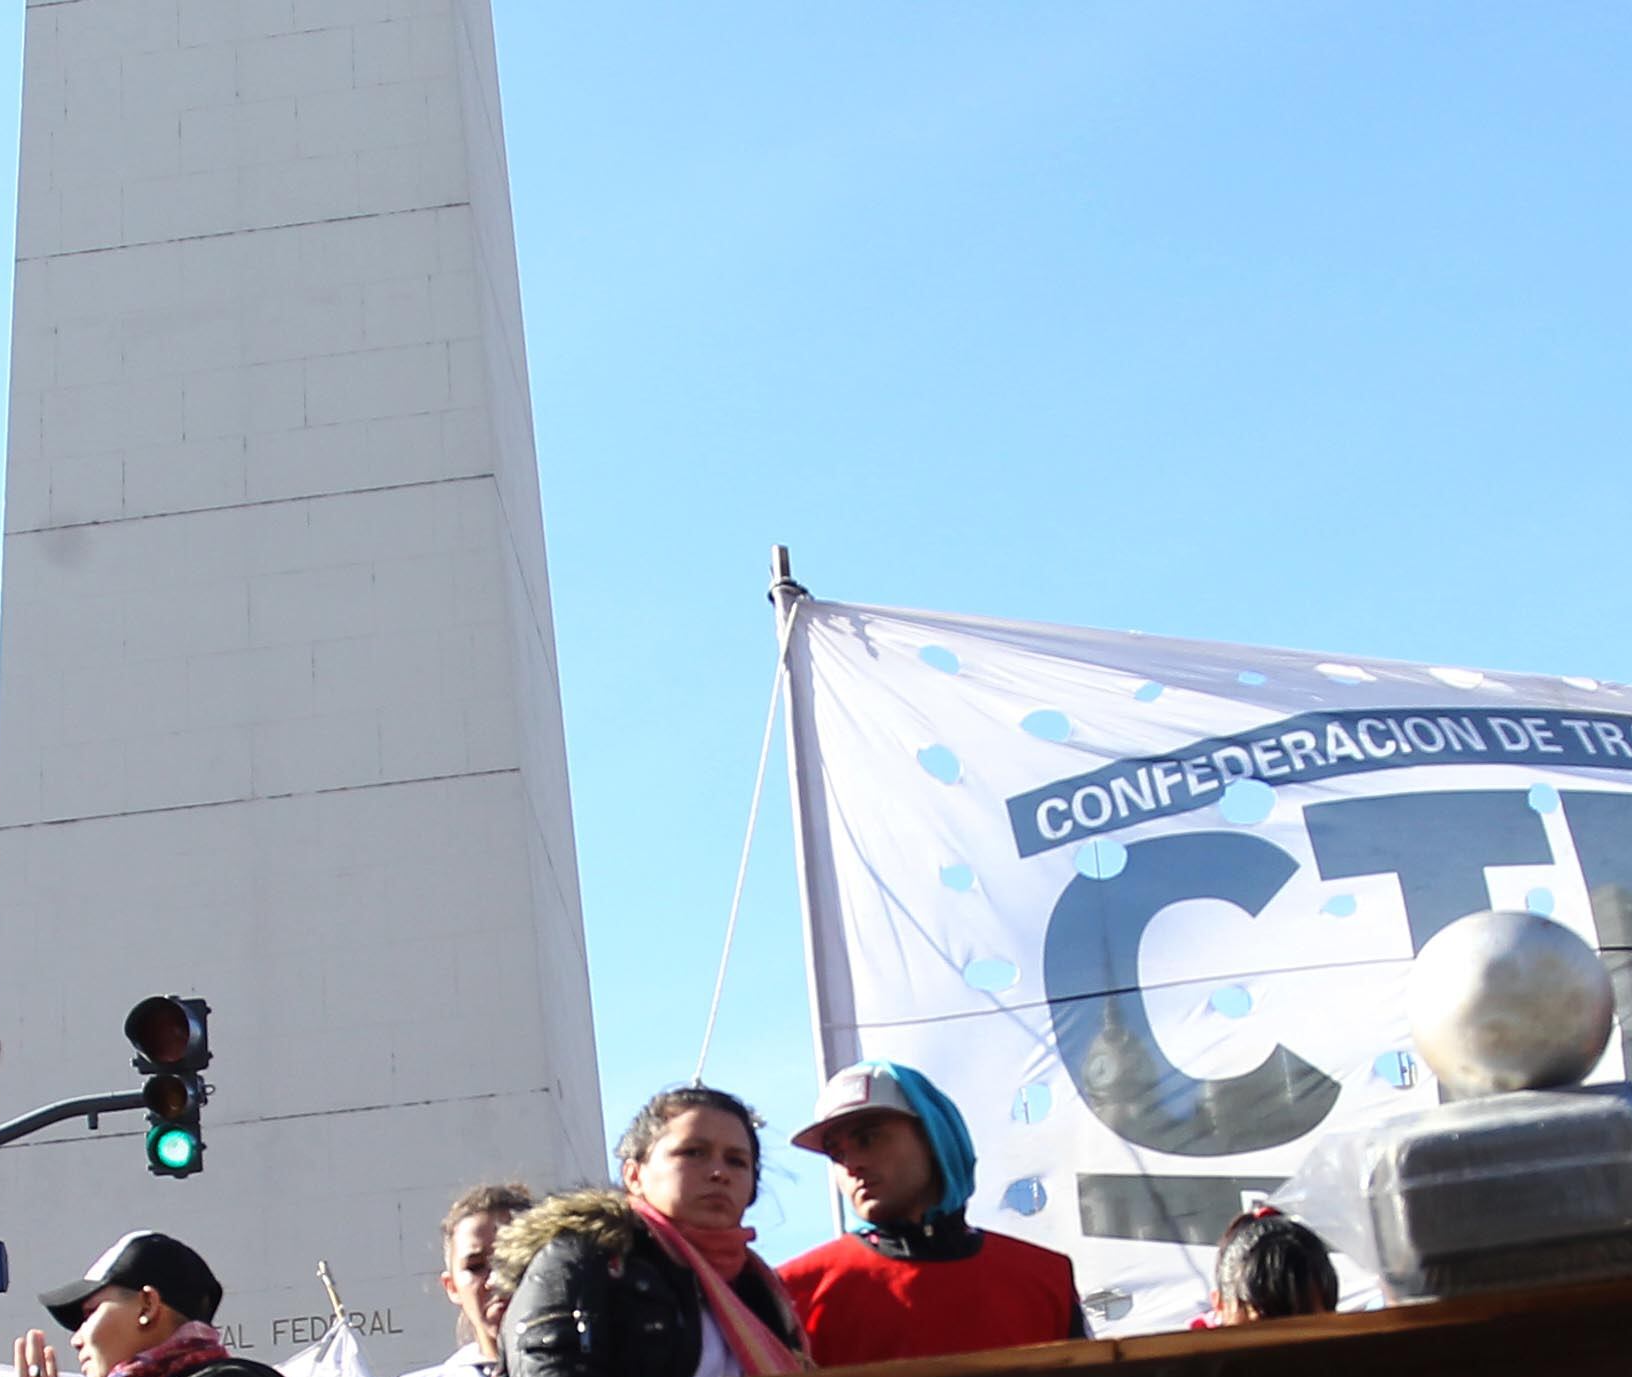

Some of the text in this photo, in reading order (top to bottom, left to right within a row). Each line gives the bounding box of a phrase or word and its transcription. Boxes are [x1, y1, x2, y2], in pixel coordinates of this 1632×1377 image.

[1035, 715, 1487, 842] CONFEDERACION
[1487, 716, 1564, 754] DE
[272, 1308, 404, 1345] FEDRAL
